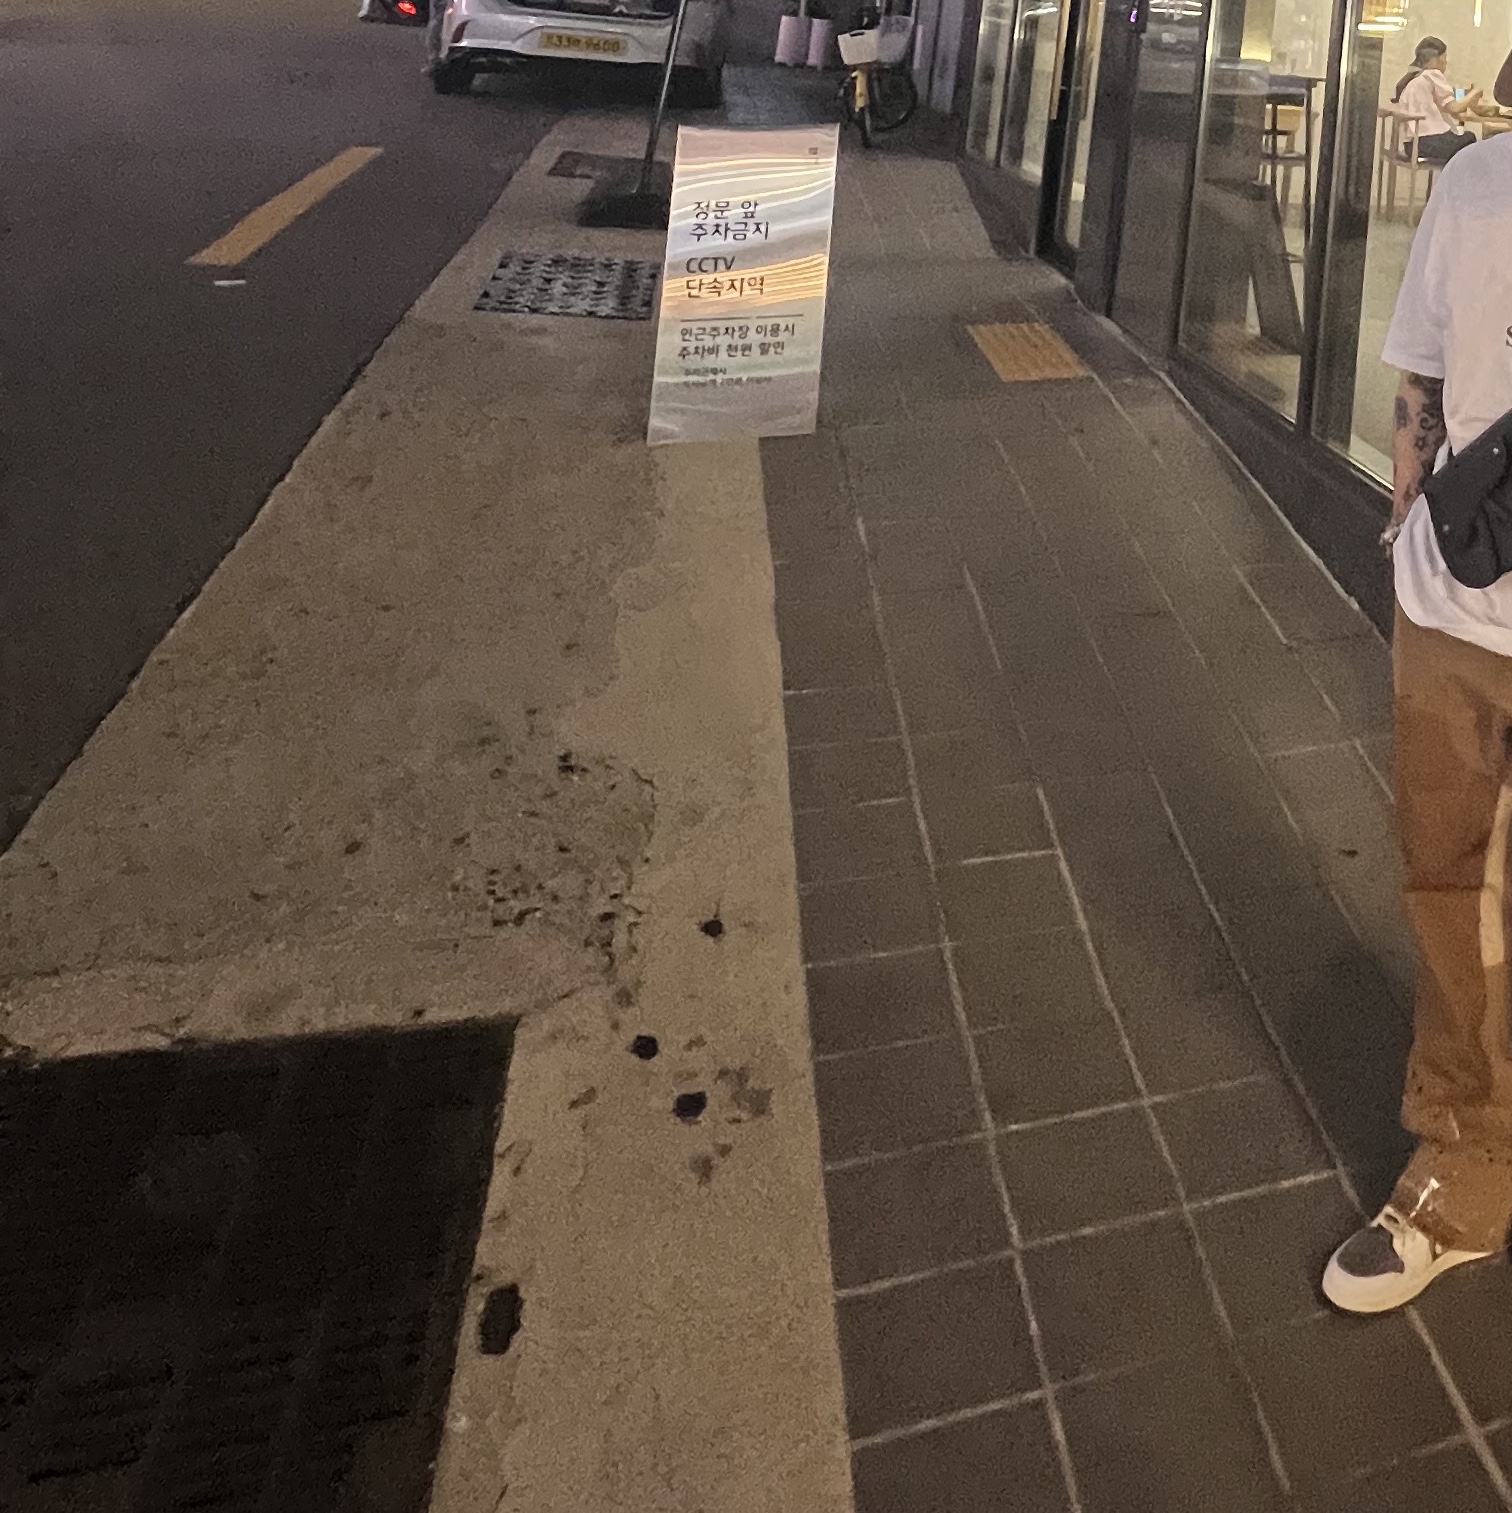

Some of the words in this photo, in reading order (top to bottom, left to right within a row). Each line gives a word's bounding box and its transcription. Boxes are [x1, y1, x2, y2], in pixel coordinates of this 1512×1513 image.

[692, 199, 732, 220] 정문
[740, 200, 760, 219] 앞
[688, 220, 770, 242] 주차금지
[685, 255, 736, 274] CCTV
[684, 275, 766, 299] 단속지역
[679, 325, 750, 342] 인근주차장
[755, 322, 797, 338] 이용시
